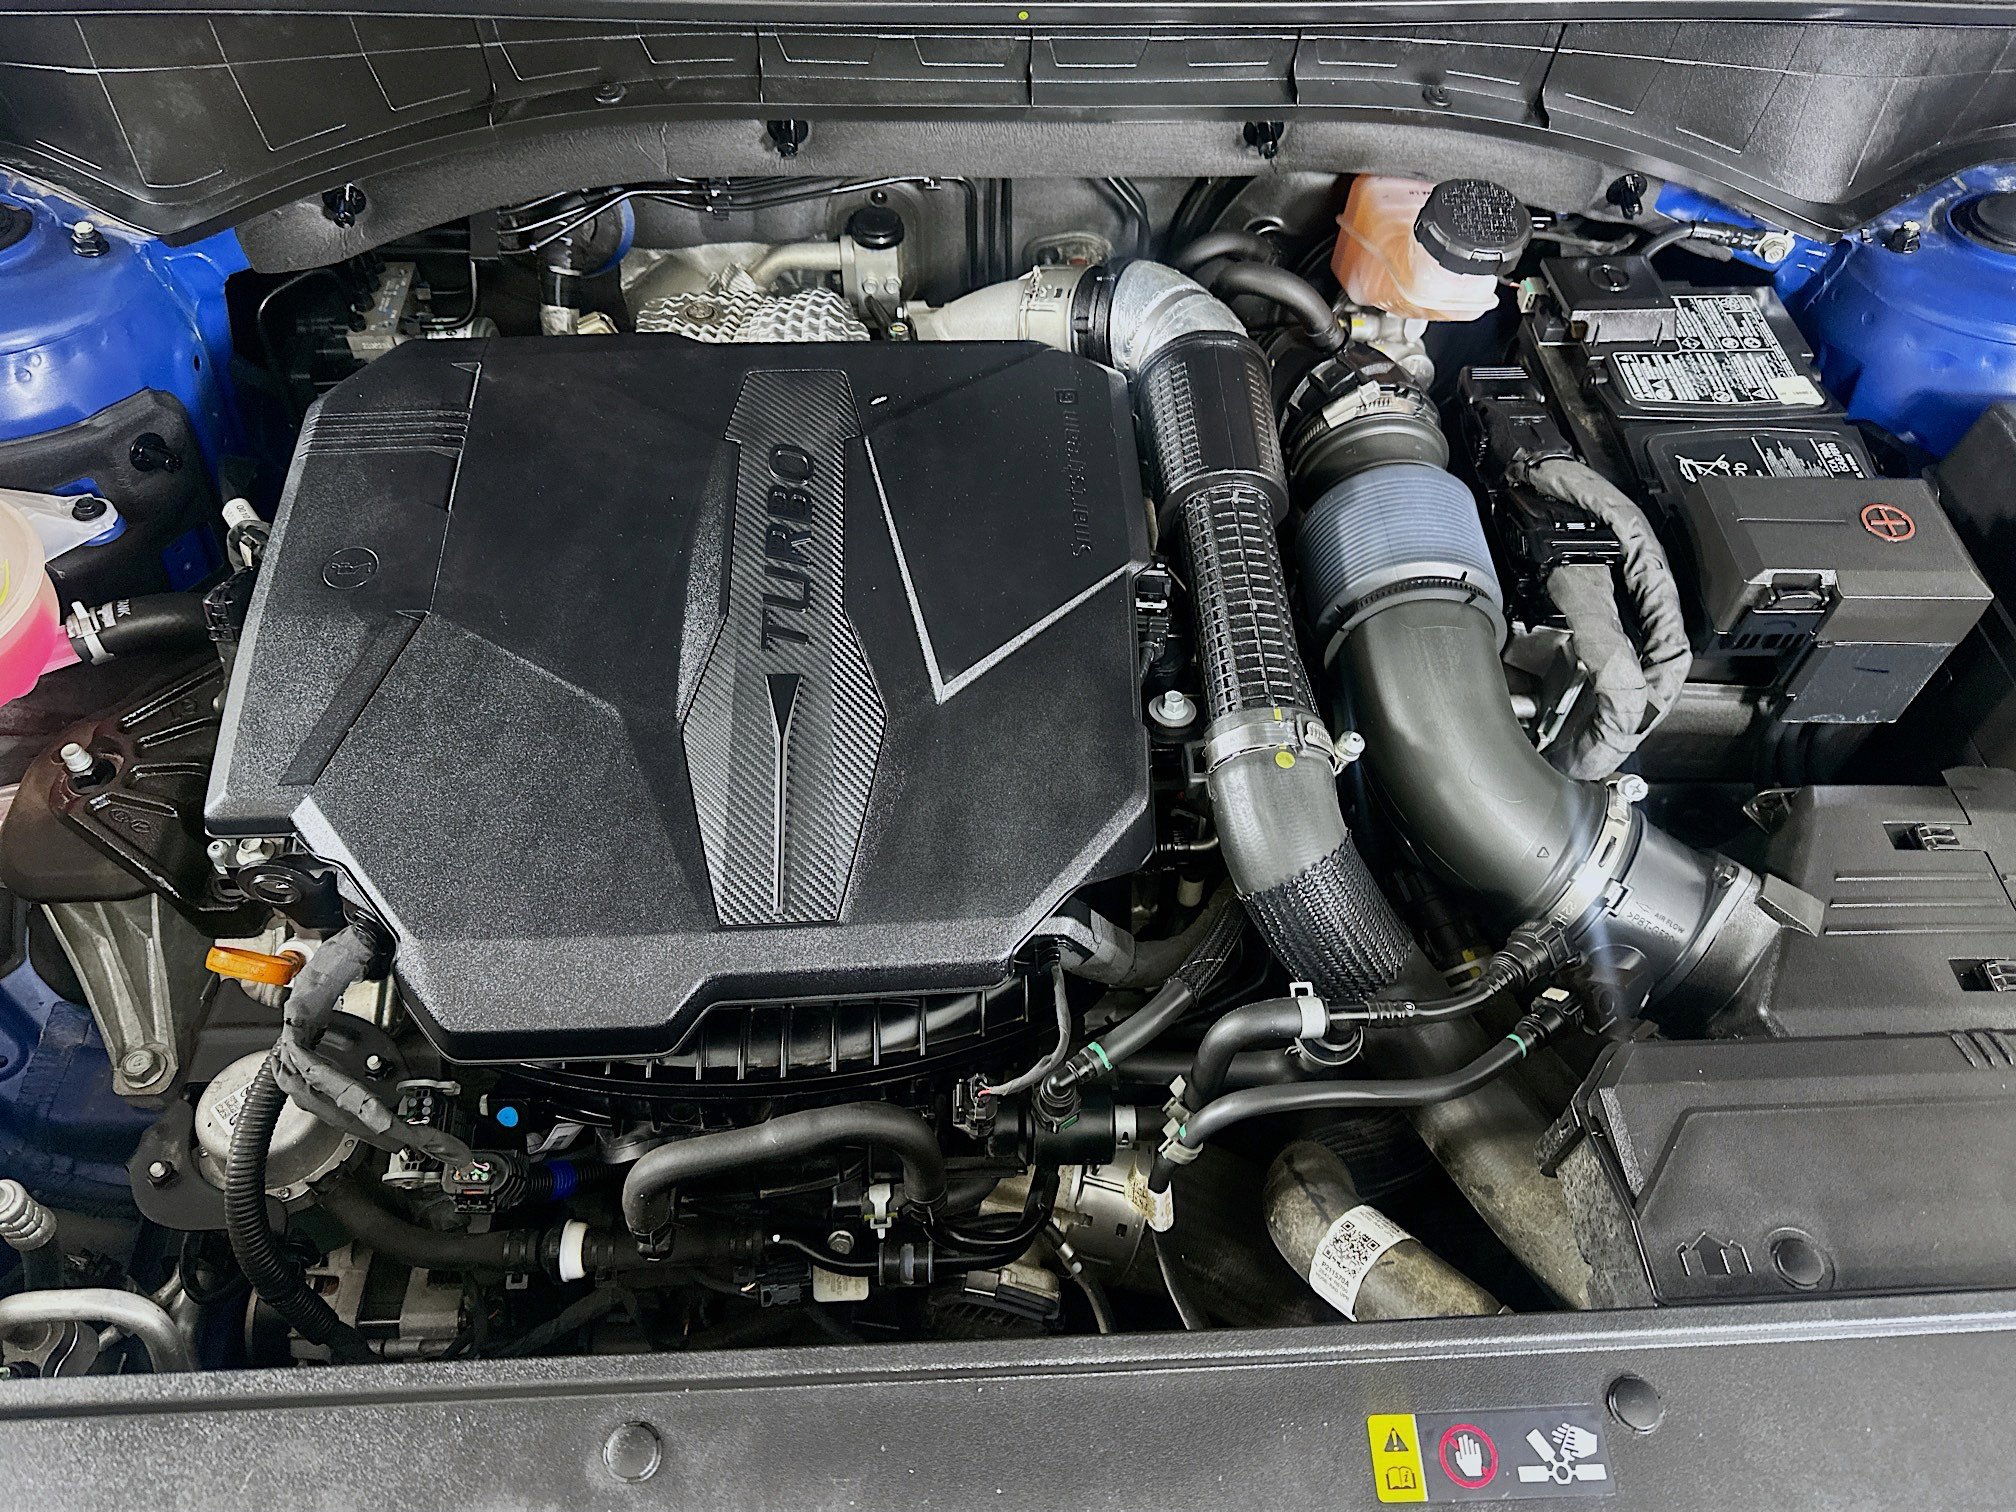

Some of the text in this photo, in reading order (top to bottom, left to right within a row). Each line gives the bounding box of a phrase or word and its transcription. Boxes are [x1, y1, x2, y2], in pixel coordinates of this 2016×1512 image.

[761, 443, 815, 650] TURBO
[1062, 410, 1093, 559] Smartstream
[1654, 912, 1686, 934] AIR FLOW
